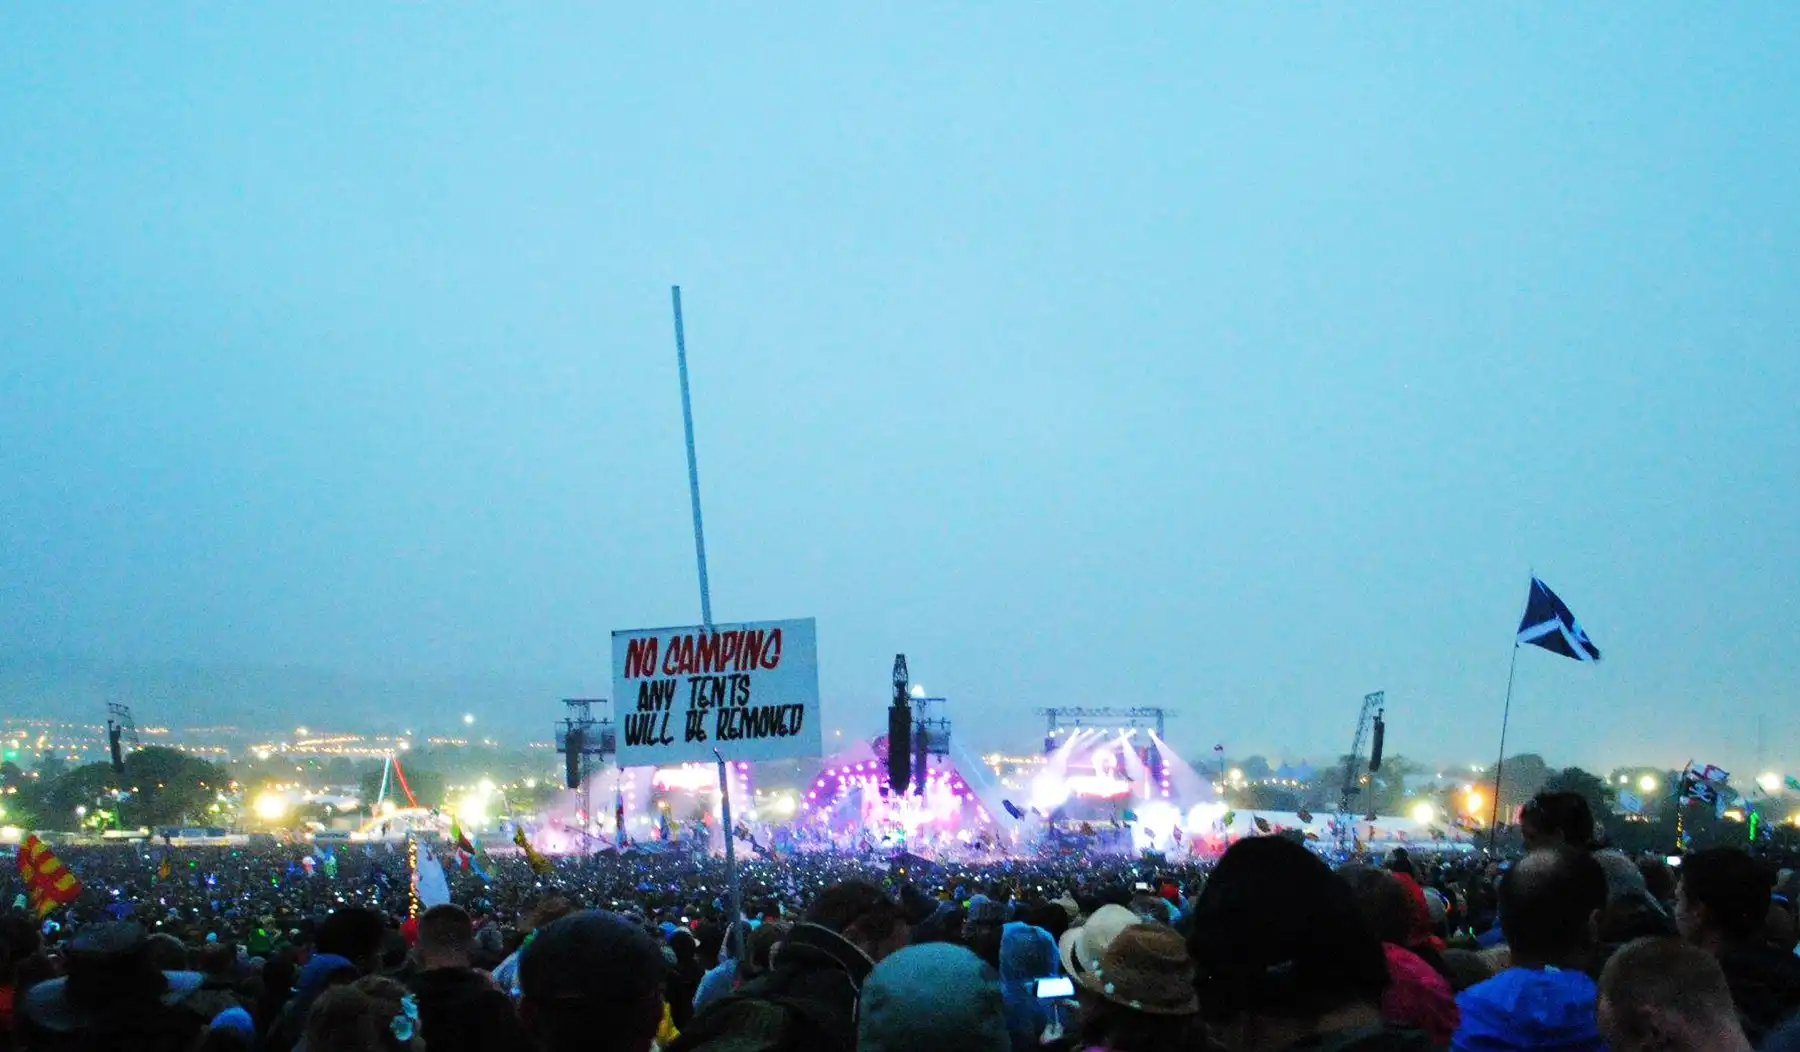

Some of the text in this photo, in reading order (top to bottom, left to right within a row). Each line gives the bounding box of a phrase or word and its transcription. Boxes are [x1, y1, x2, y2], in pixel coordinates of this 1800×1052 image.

[624, 628, 783, 678] NO CAMPING
[637, 673, 751, 712] ANY TENTS
[624, 703, 804, 746] WILL BE REMOVED
